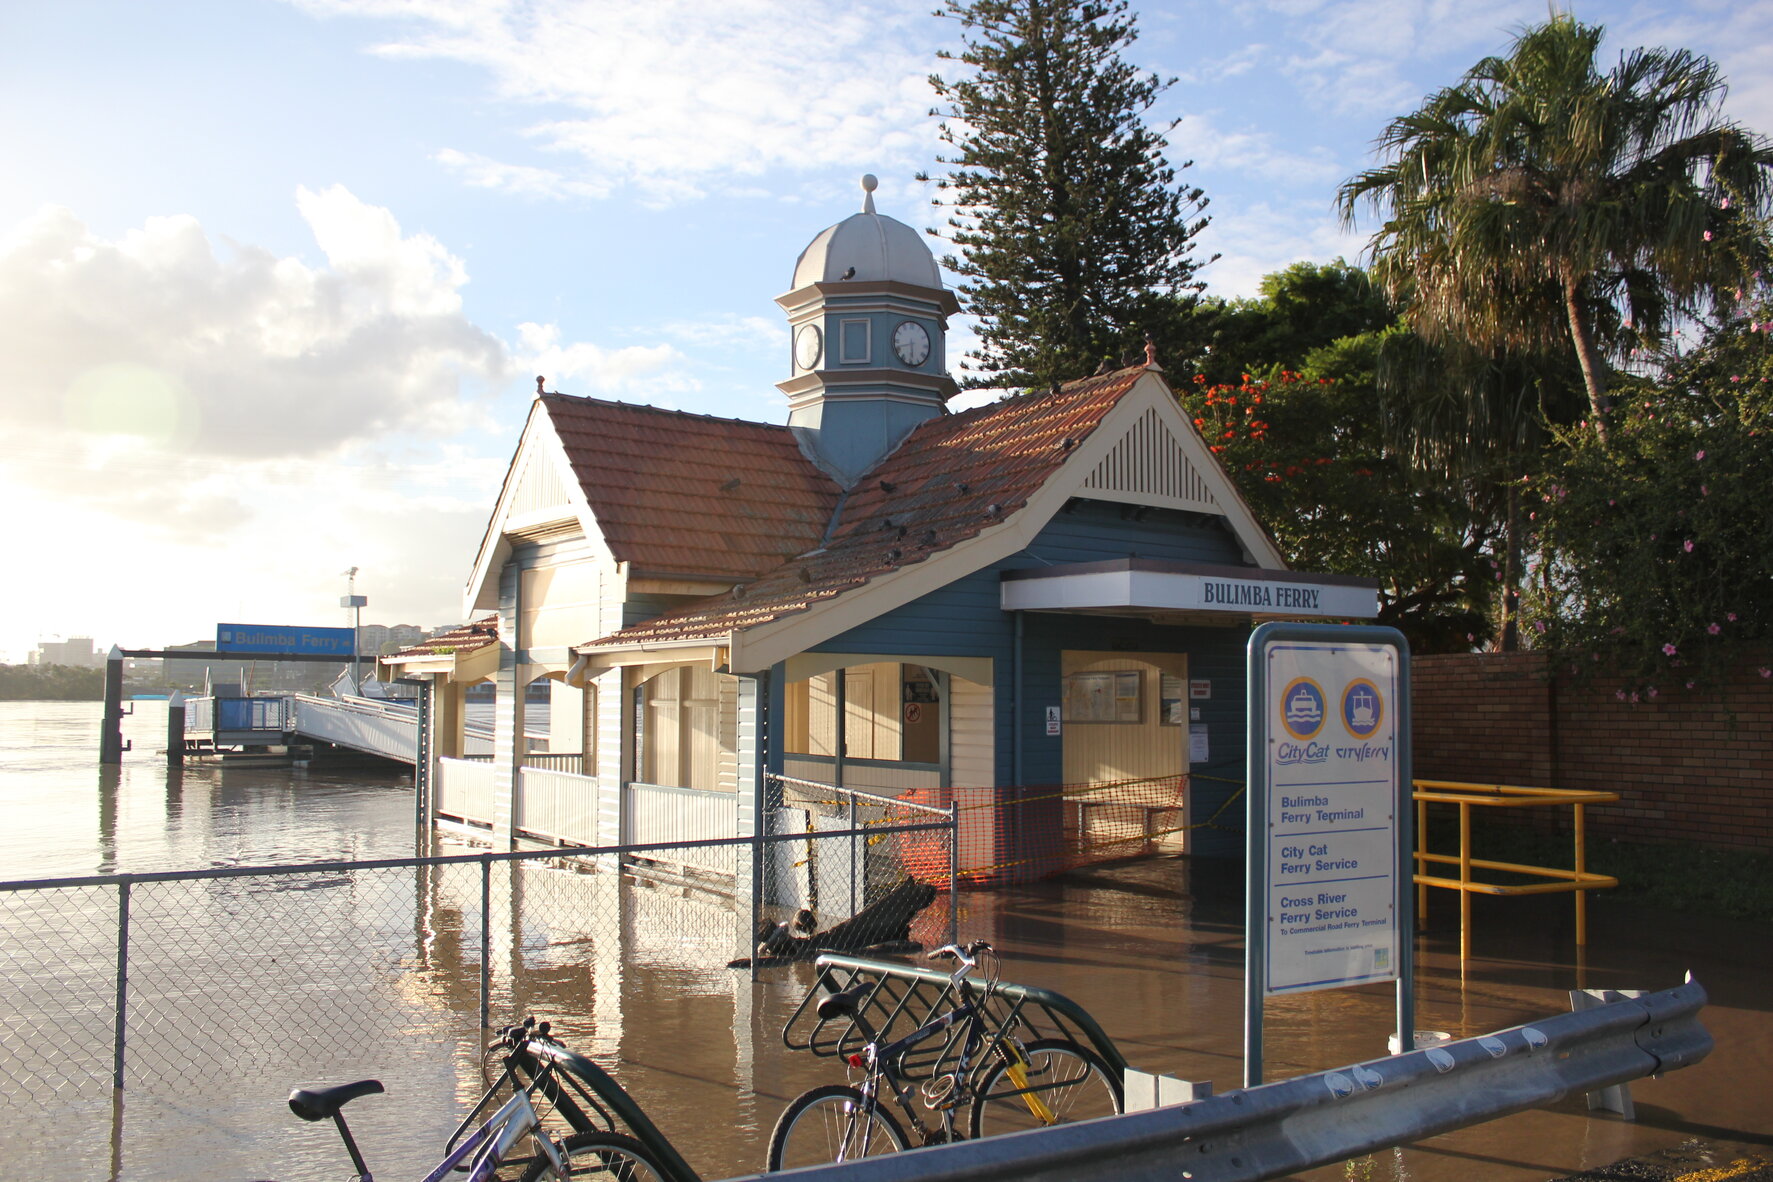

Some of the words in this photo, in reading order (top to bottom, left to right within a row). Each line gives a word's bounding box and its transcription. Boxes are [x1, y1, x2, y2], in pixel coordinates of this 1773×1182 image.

[1204, 582, 1271, 606] BULIMBA
[1276, 587, 1319, 609] FERRY
[236, 632, 296, 646] Bulimba
[302, 634, 338, 649] Ferry
[1278, 741, 1330, 762] CityCat
[1281, 796, 1329, 808] Bulimba
[1281, 812, 1312, 825] Ferry
[1316, 808, 1364, 822] Terminal
[1281, 847, 1304, 859] City
[1308, 844, 1328, 856] Cat
[1280, 862, 1311, 875] Ferry
[1315, 858, 1358, 872] Service
[1280, 897, 1314, 909] Cross
[1317, 893, 1347, 905] River
[1280, 912, 1311, 925] Ferry
[1315, 907, 1358, 921] Service
[1289, 925, 1326, 935] Commercial
[1327, 923, 1343, 931] Road
[1344, 921, 1360, 930] Ferry
[1361, 918, 1387, 927] Terminal
